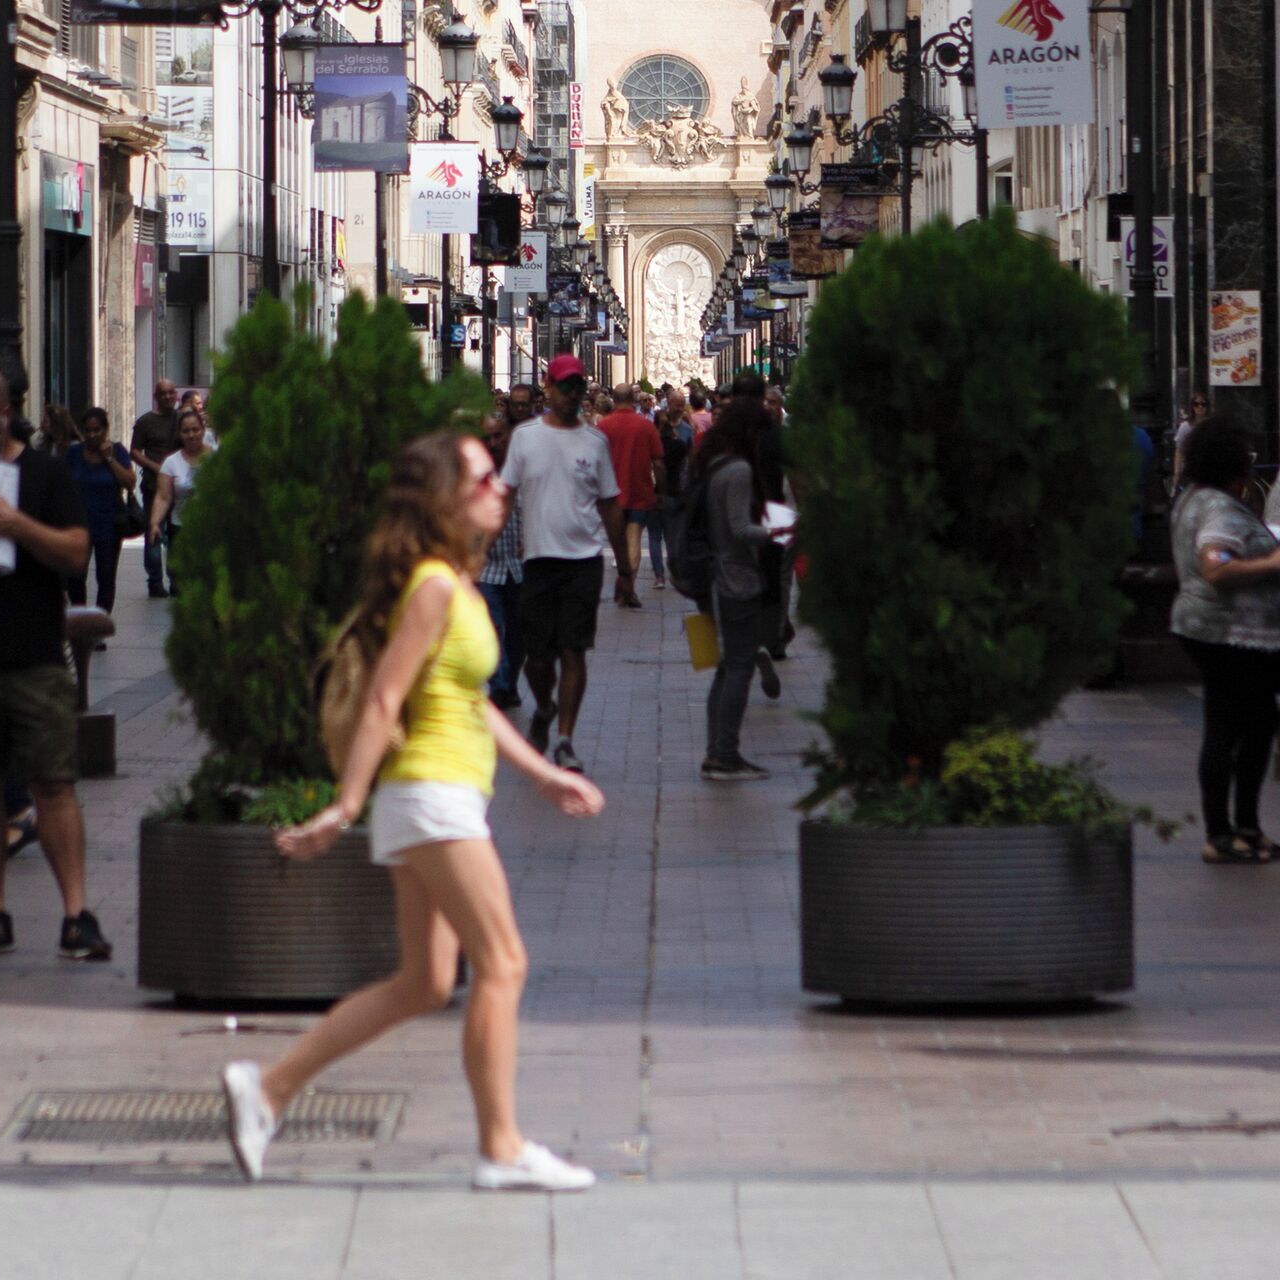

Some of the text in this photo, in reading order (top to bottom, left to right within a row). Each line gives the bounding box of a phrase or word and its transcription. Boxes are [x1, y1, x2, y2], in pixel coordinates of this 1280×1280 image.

[988, 41, 1081, 66] ARAGÓN
[316, 64, 390, 74] del Serrablo
[418, 188, 472, 200] ARAGÓN
[585, 185, 593, 210] ULMA
[168, 211, 207, 228] 19 115
[1126, 265, 1168, 278] TO
